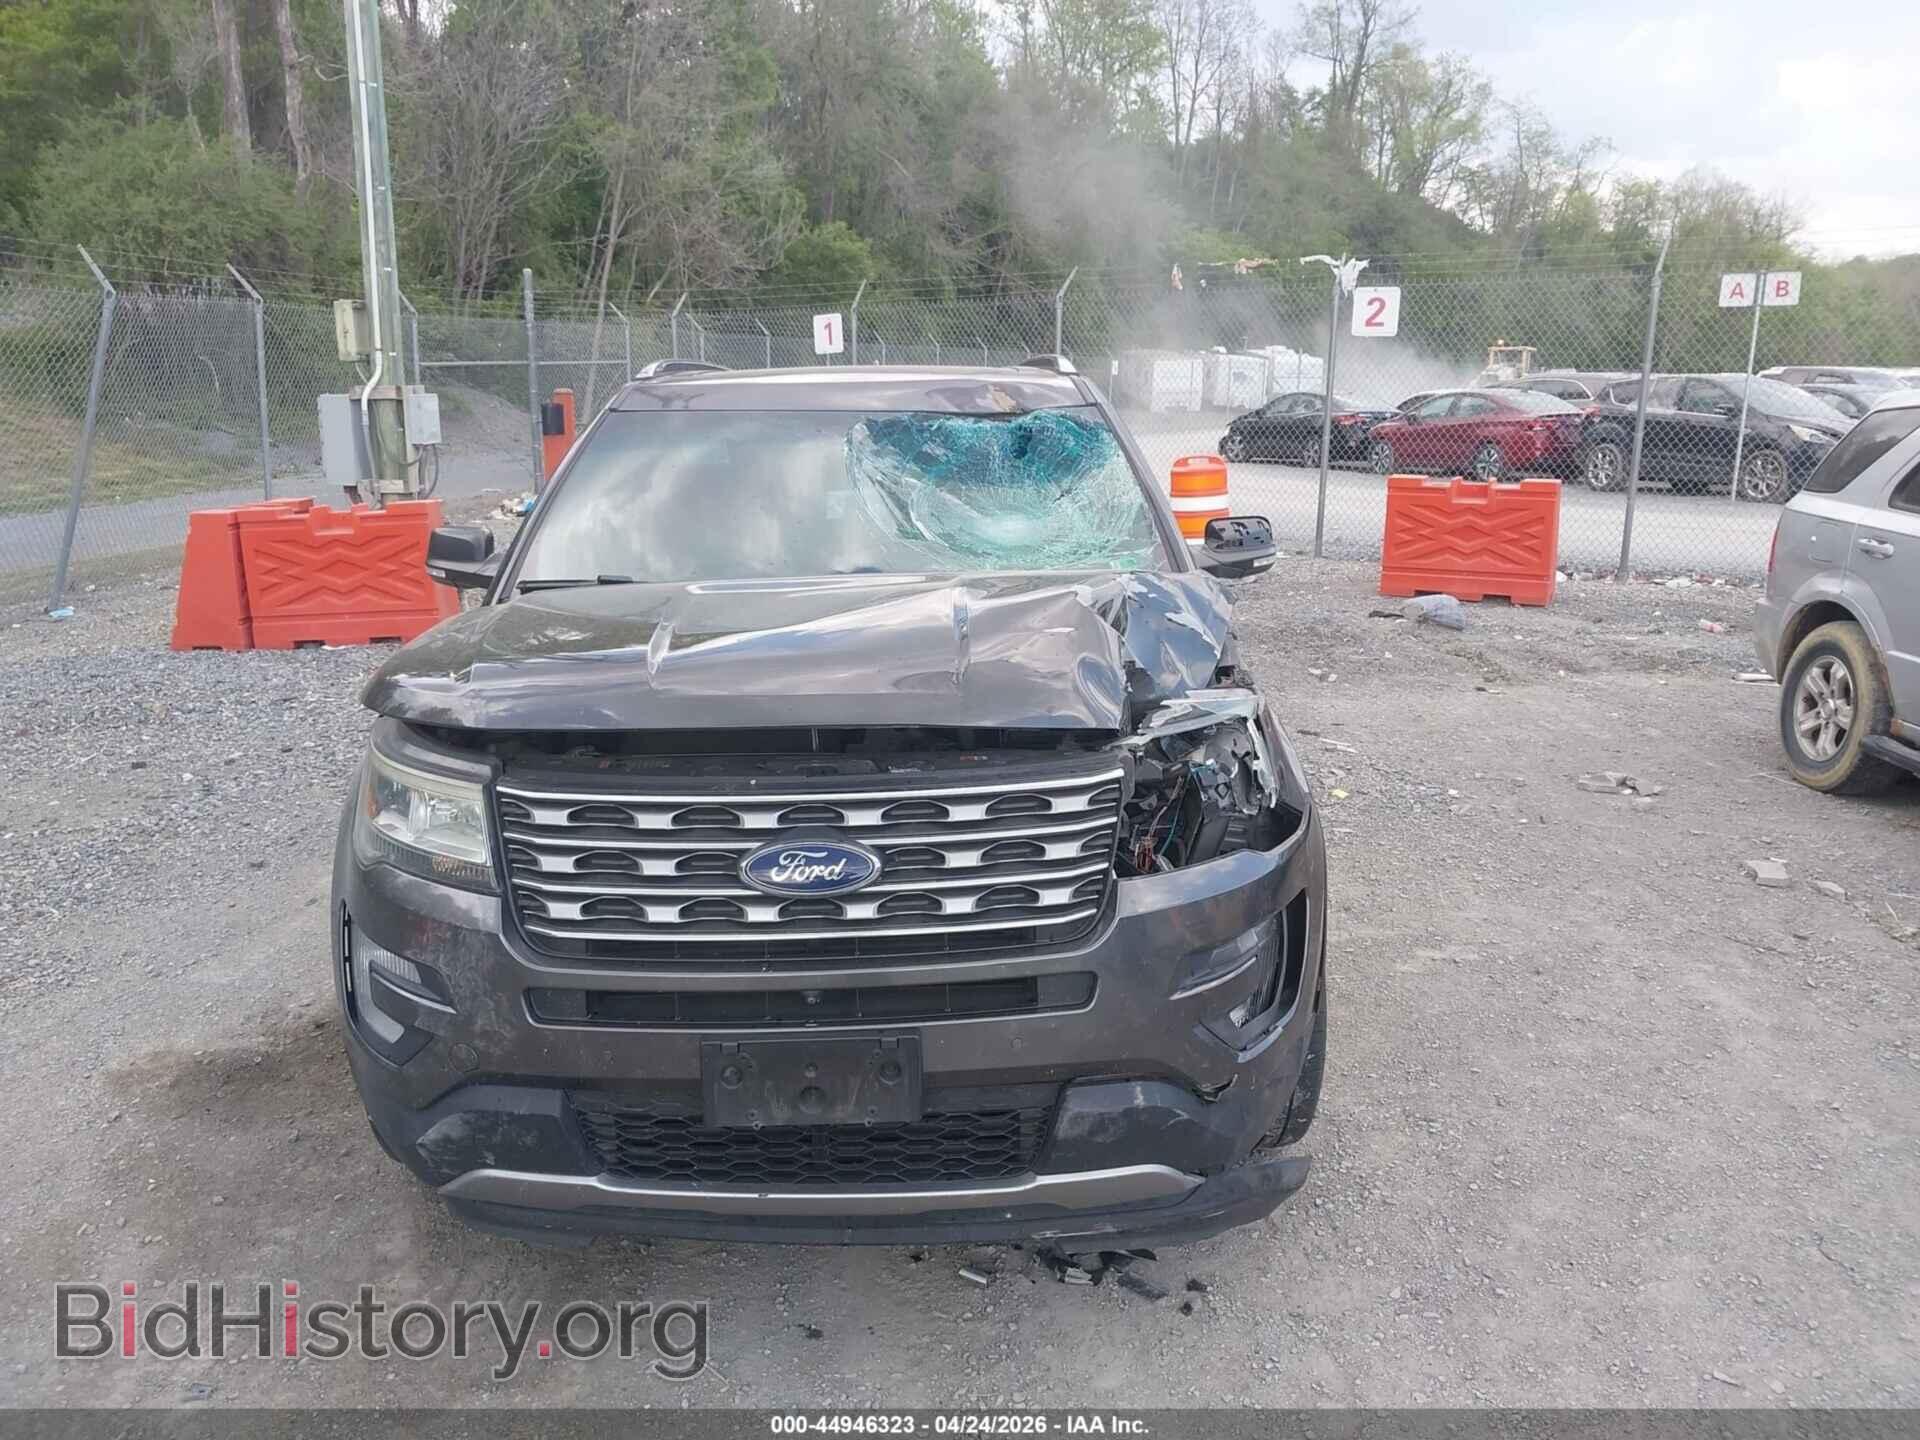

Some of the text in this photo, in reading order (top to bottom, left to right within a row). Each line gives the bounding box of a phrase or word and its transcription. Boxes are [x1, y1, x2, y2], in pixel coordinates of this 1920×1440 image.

[1729, 282, 1745, 299] A
[1775, 280, 1790, 297] B
[1364, 296, 1388, 328] 2
[823, 321, 834, 346] 1
[770, 850, 847, 884] Ford
